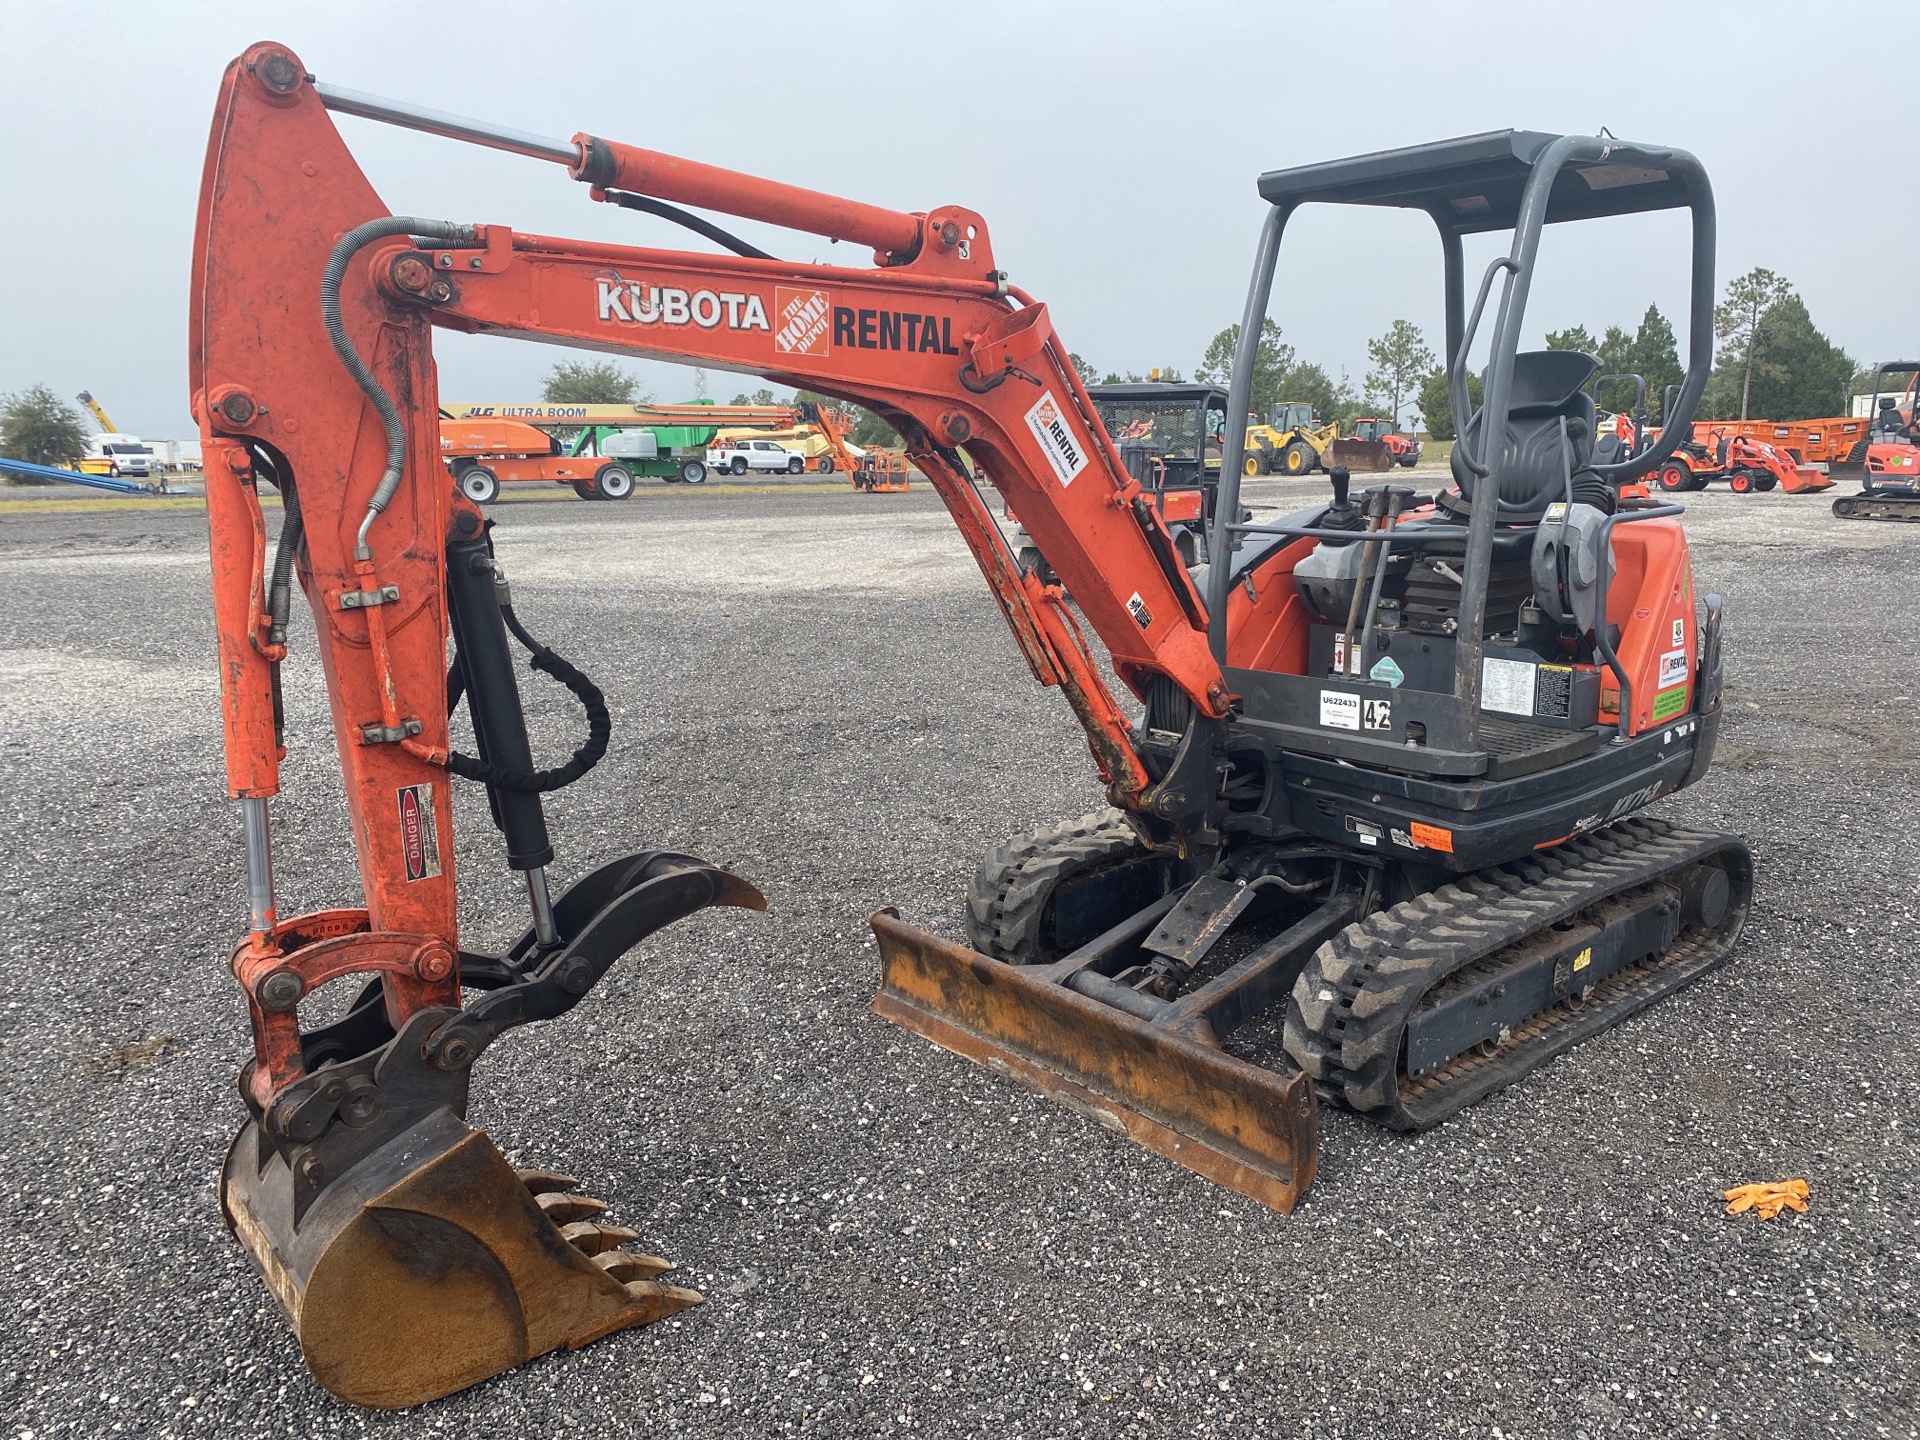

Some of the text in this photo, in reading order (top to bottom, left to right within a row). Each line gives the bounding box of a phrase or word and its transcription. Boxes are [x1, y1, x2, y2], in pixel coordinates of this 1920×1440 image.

[598, 281, 771, 332] KUBOTA
[776, 290, 829, 352] HOME
[781, 295, 804, 320] THE
[833, 306, 960, 355] RENTAL
[797, 315, 829, 353] DEPOT
[502, 407, 543, 417] ULTRA
[547, 408, 587, 417] BOOM
[1032, 418, 1069, 480] homedepot.com/rental
[1049, 420, 1080, 471] RENTAL
[1323, 696, 1357, 708] U622433
[1365, 701, 1391, 729] 42
[406, 808, 420, 859] DANGER
